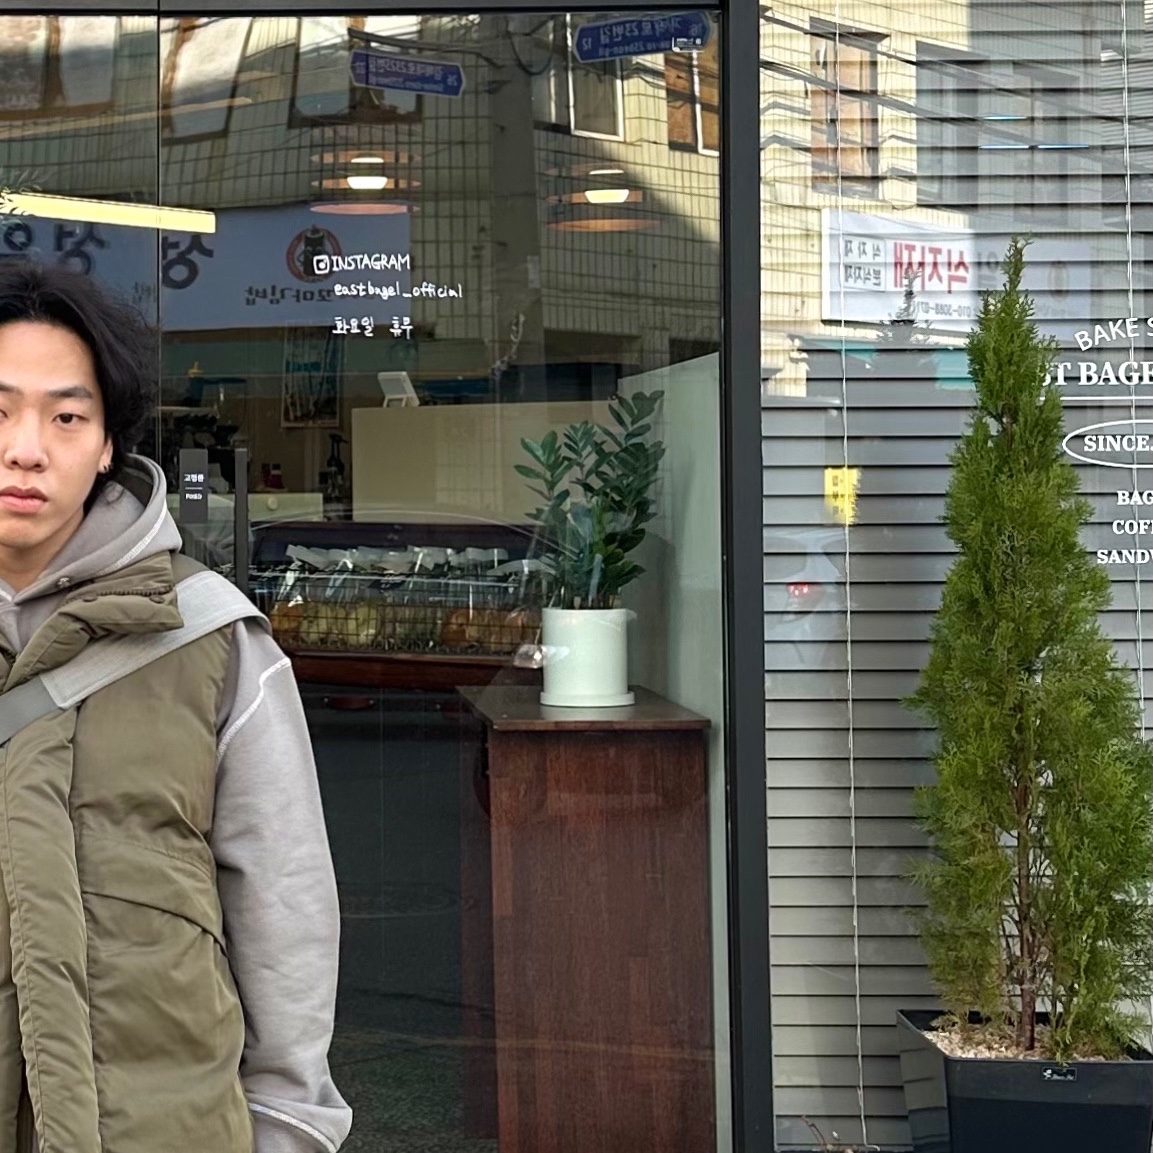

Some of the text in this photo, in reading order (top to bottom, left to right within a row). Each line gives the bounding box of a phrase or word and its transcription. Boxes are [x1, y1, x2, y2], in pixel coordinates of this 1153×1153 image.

[331, 253, 411, 271] INSTAGRAM
[334, 281, 463, 300] eastbagel_official
[332, 316, 414, 339] 화요일 휴무
[1074, 317, 1140, 352] BAKE
[1112, 519, 1153, 535] COF
[1096, 549, 1153, 565] SAND
